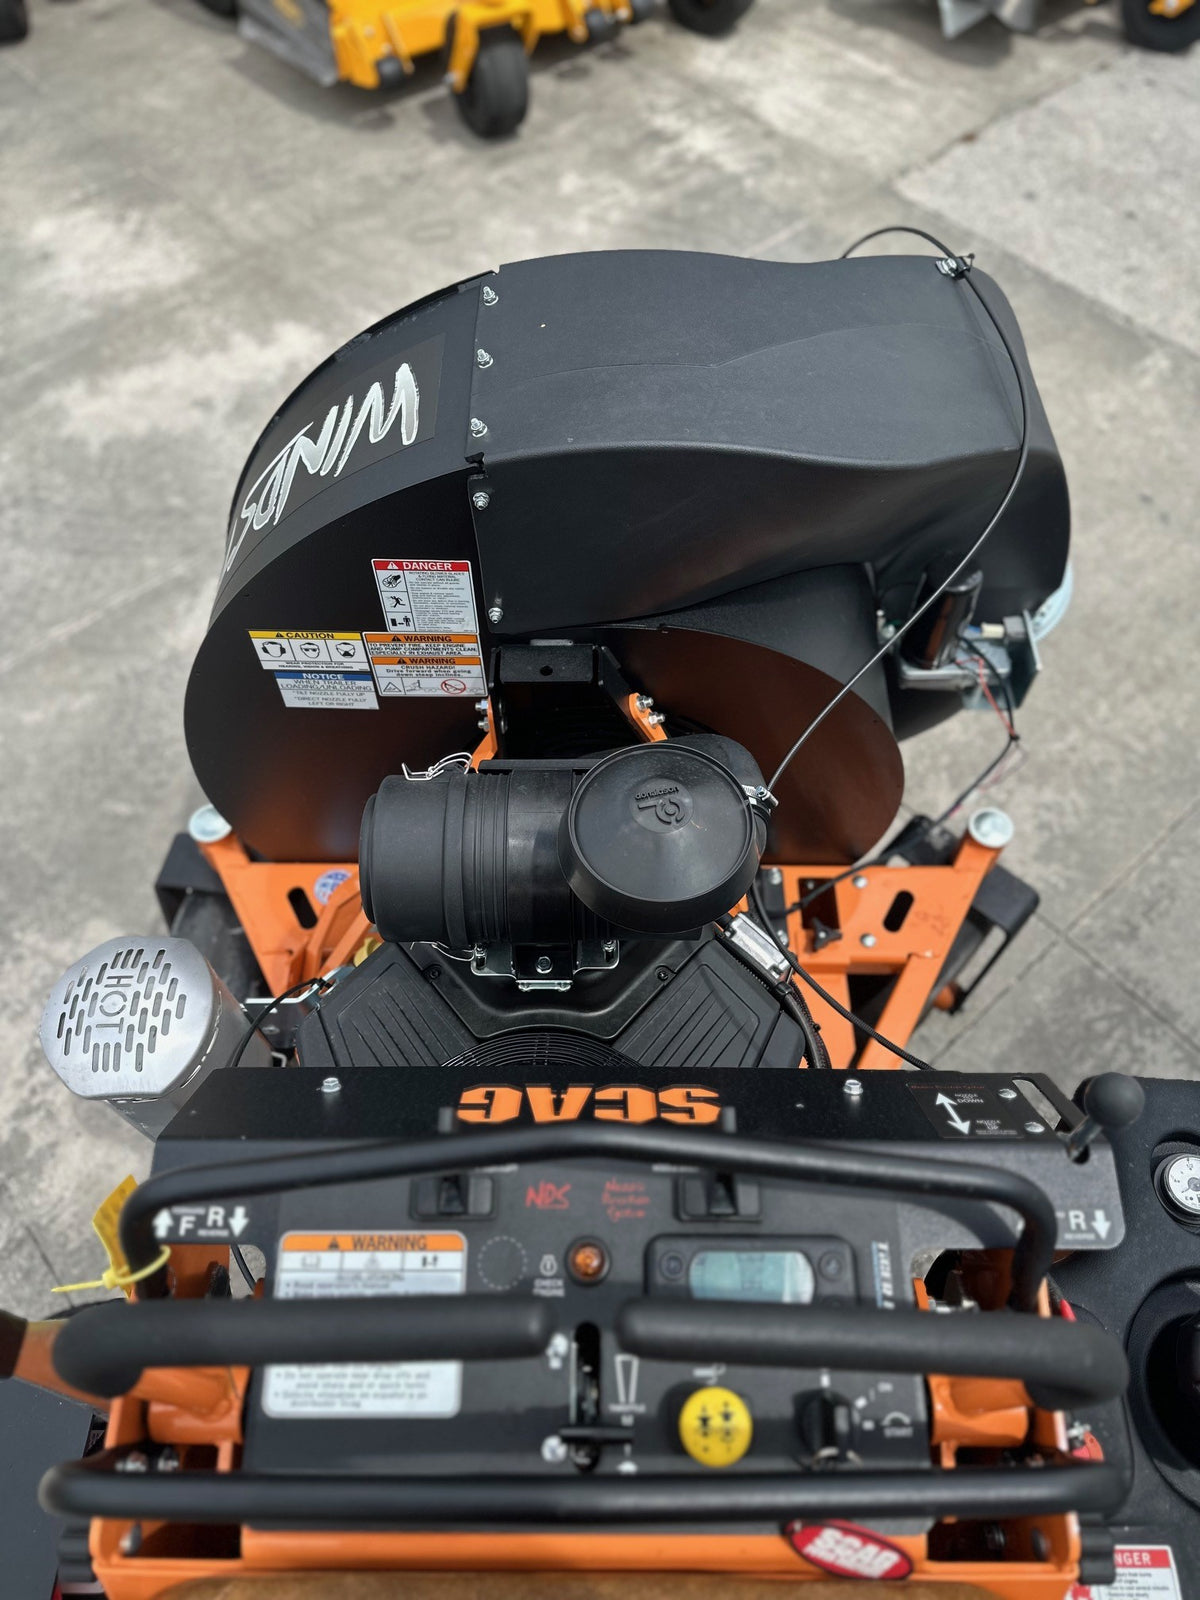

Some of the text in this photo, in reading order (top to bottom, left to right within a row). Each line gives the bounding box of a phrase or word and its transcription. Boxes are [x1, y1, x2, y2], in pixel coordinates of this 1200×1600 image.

[403, 561, 452, 571] DANGER
[95, 975, 134, 1034] HOT
[456, 1084, 722, 1125] SCAG
[179, 1216, 196, 1236] F
[207, 1206, 225, 1227] R
[1068, 1210, 1087, 1231] R
[352, 1233, 427, 1251] WARNING
[1114, 1551, 1152, 1566] NGER
